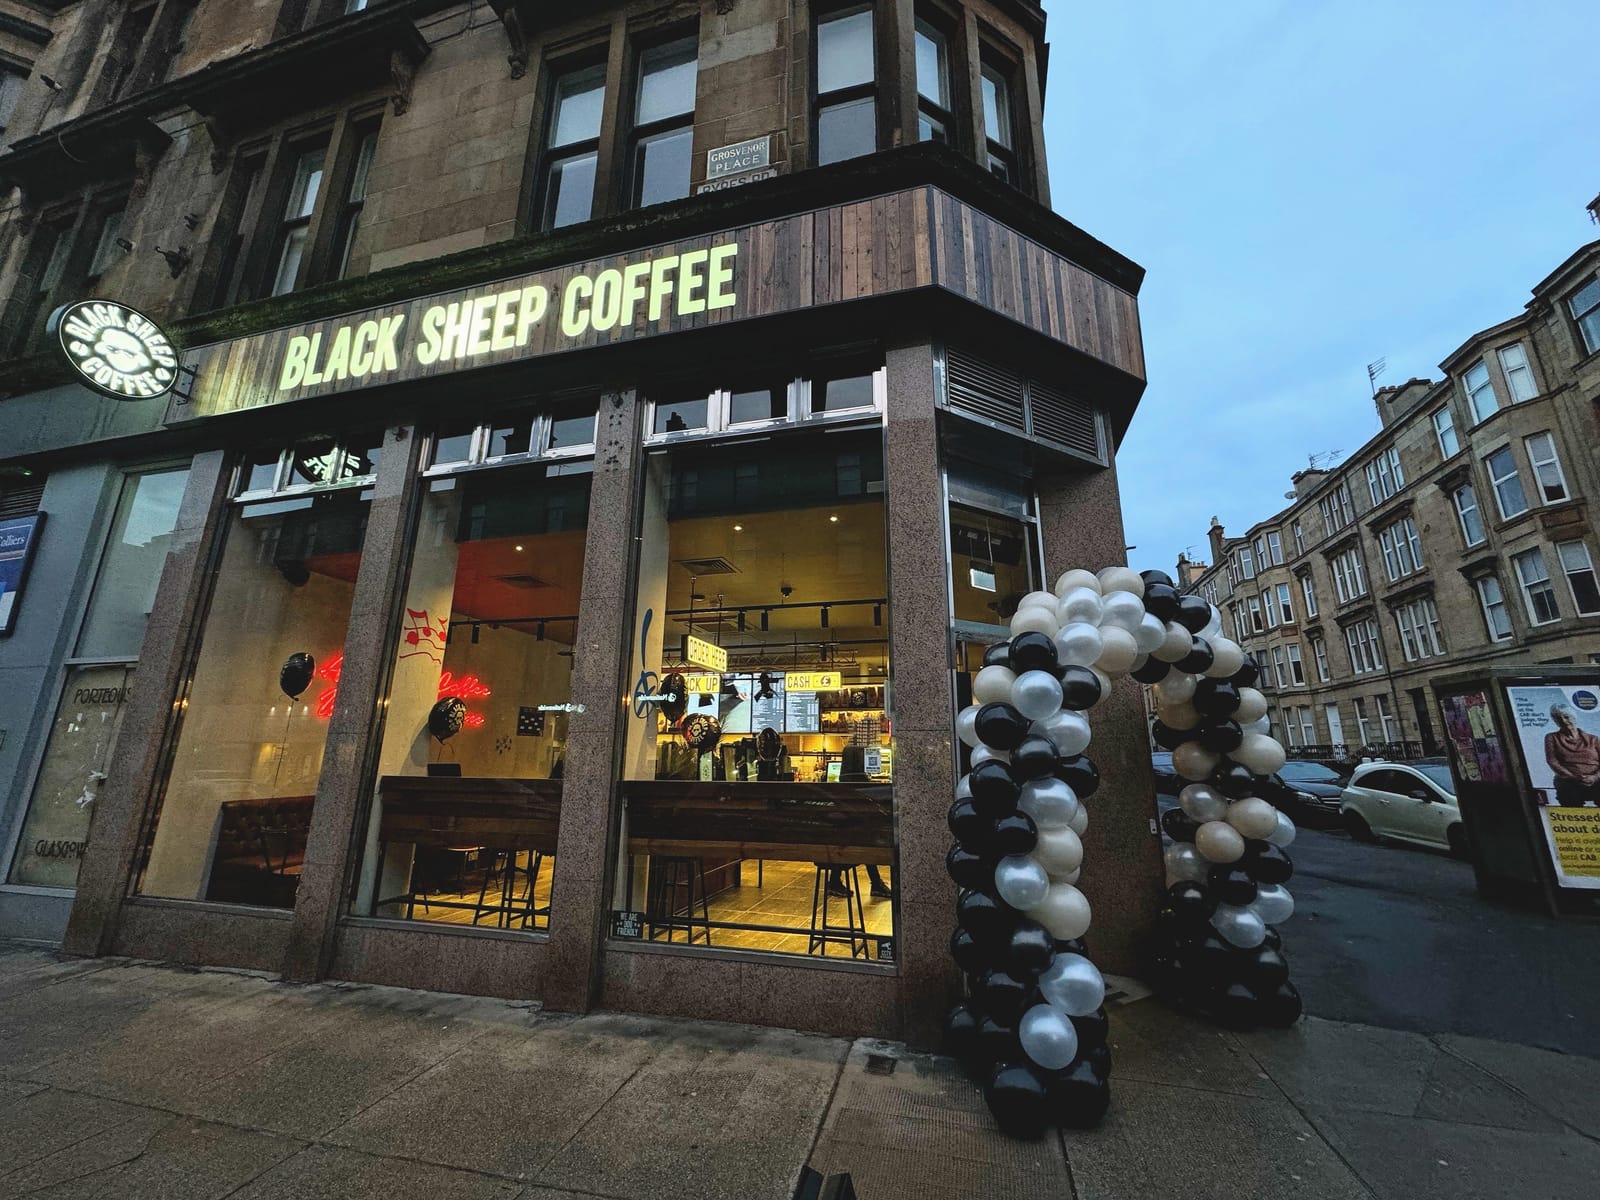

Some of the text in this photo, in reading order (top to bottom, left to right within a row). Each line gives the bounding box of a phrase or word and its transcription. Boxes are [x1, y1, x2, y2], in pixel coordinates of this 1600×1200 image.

[711, 142, 766, 162] GROSVENOR
[716, 154, 760, 173] PLACE
[280, 243, 738, 390] BLACK SHEEP COFFEE
[65, 303, 176, 368] BLACK SHEEP
[80, 356, 165, 396] COFFEE
[690, 639, 708, 665] ORDER
[706, 677, 718, 691] UP
[787, 676, 810, 688] CASH
[1550, 812, 1600, 822] Stressed
[1553, 824, 1589, 834] about
[1559, 845, 1584, 853] online
[617, 927, 638, 936] FRIENDLY
